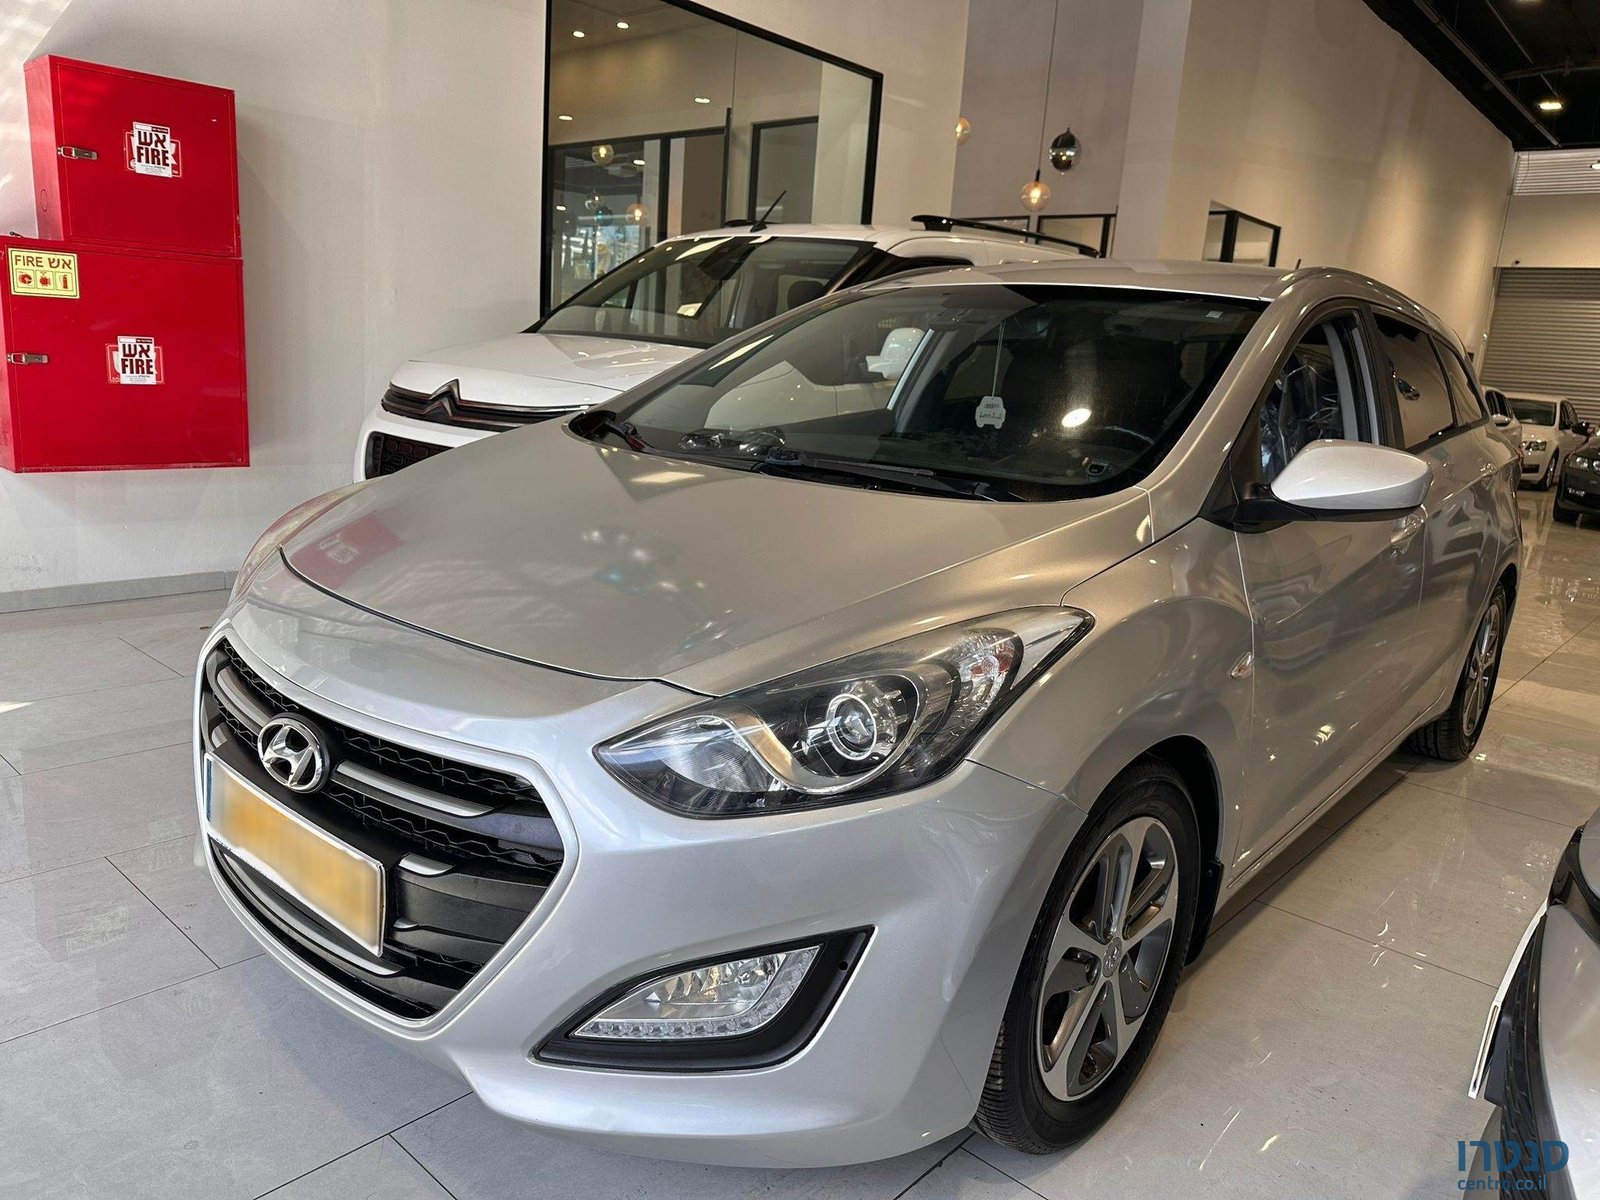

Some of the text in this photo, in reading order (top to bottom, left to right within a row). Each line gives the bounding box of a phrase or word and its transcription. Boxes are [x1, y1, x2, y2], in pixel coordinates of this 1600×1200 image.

[137, 130, 167, 149] אש
[136, 145, 170, 167] FIRE
[14, 254, 72, 270] FIRE אש
[122, 343, 151, 358] אש
[121, 358, 154, 375] FIRE
